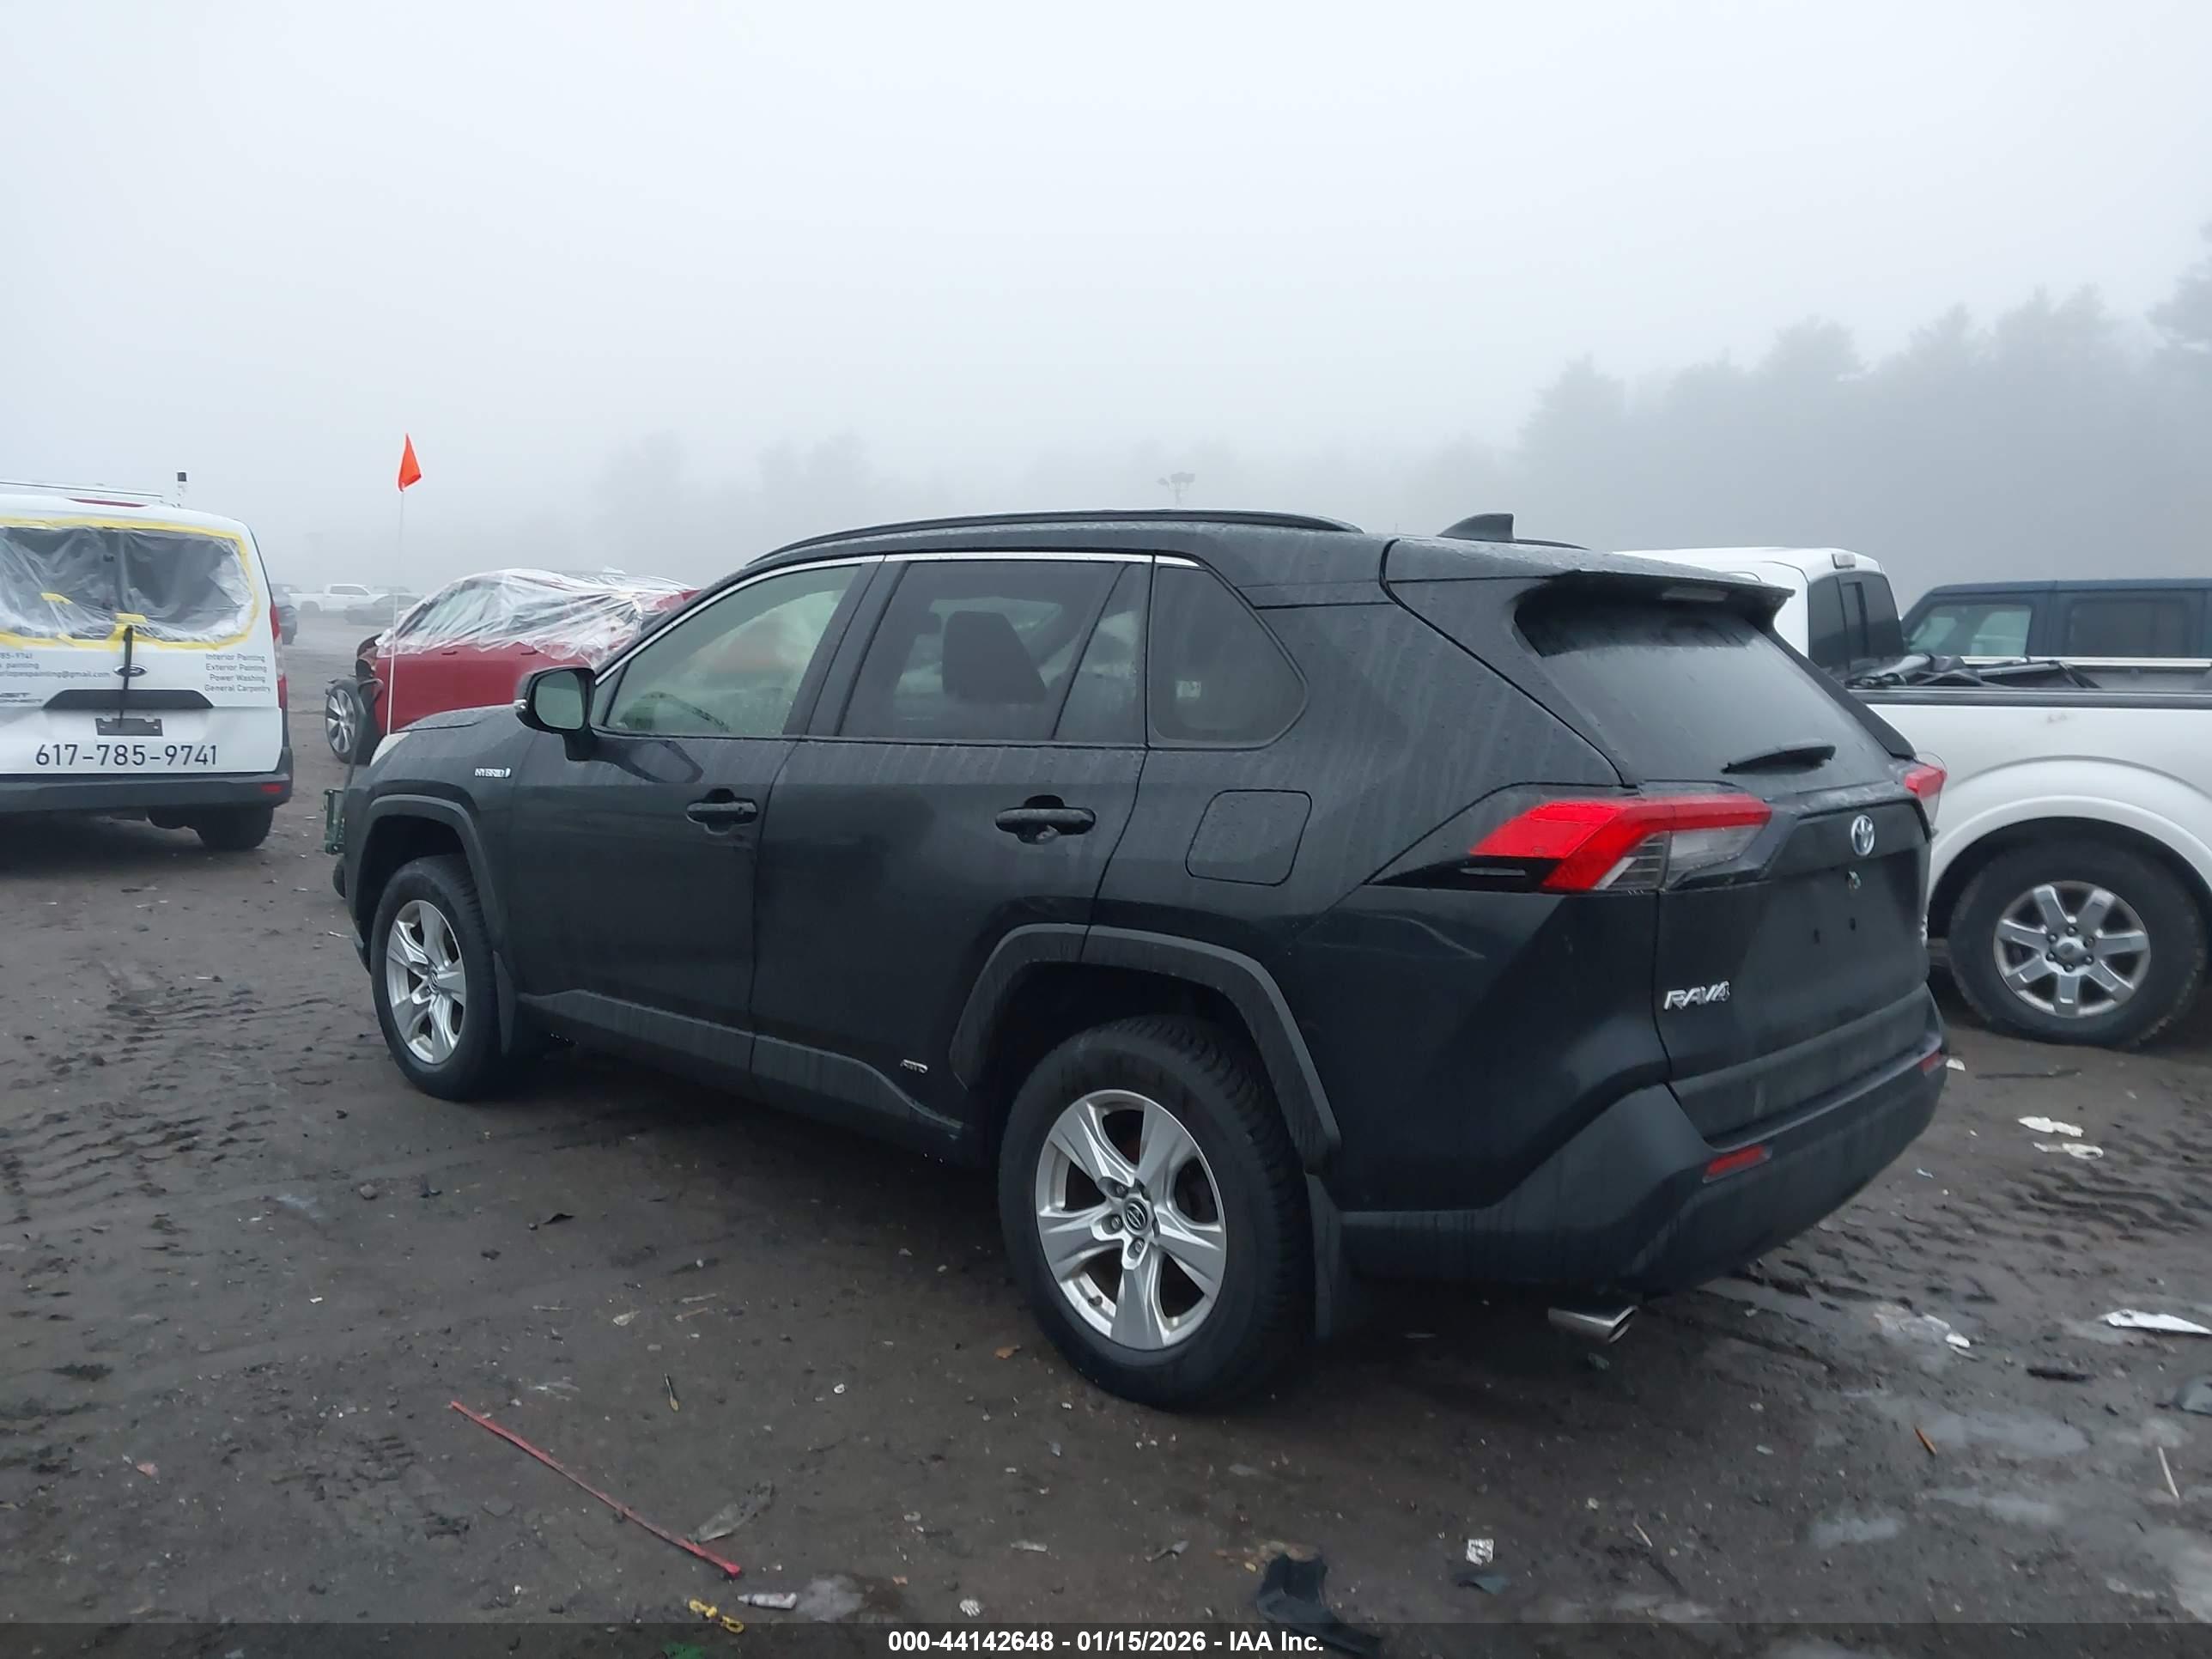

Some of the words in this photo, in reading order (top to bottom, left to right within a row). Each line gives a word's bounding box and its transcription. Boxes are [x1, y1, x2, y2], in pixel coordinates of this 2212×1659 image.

[237, 653, 265, 662] Painting
[239, 663, 267, 672] Painting
[236, 674, 265, 683] Washing
[237, 684, 270, 693] Carpentry
[35, 744, 217, 766] 617-785-9741
[1663, 980, 1730, 1010] RAV4
